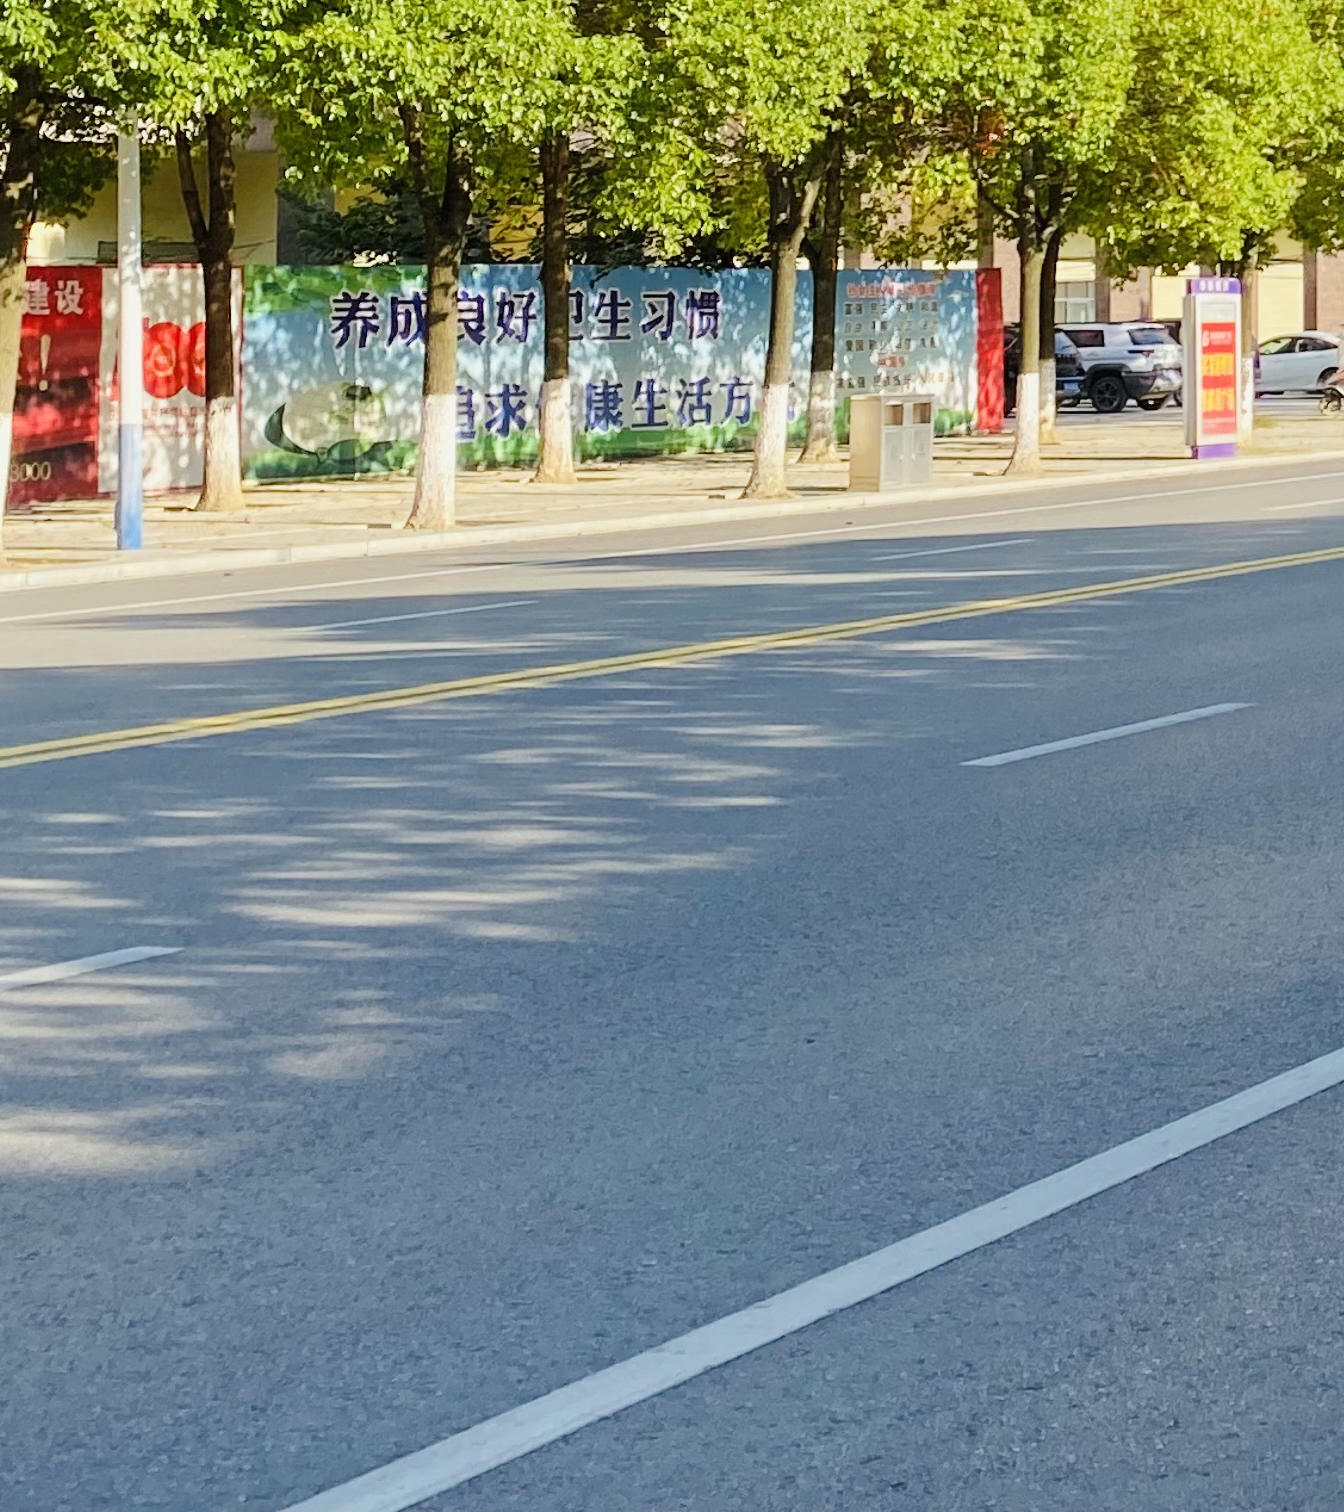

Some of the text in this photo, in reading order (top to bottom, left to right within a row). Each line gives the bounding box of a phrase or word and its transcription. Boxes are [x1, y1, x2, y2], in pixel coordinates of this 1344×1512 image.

[24, 279, 84, 316] 建设
[456, 376, 796, 438] 求康生活方
